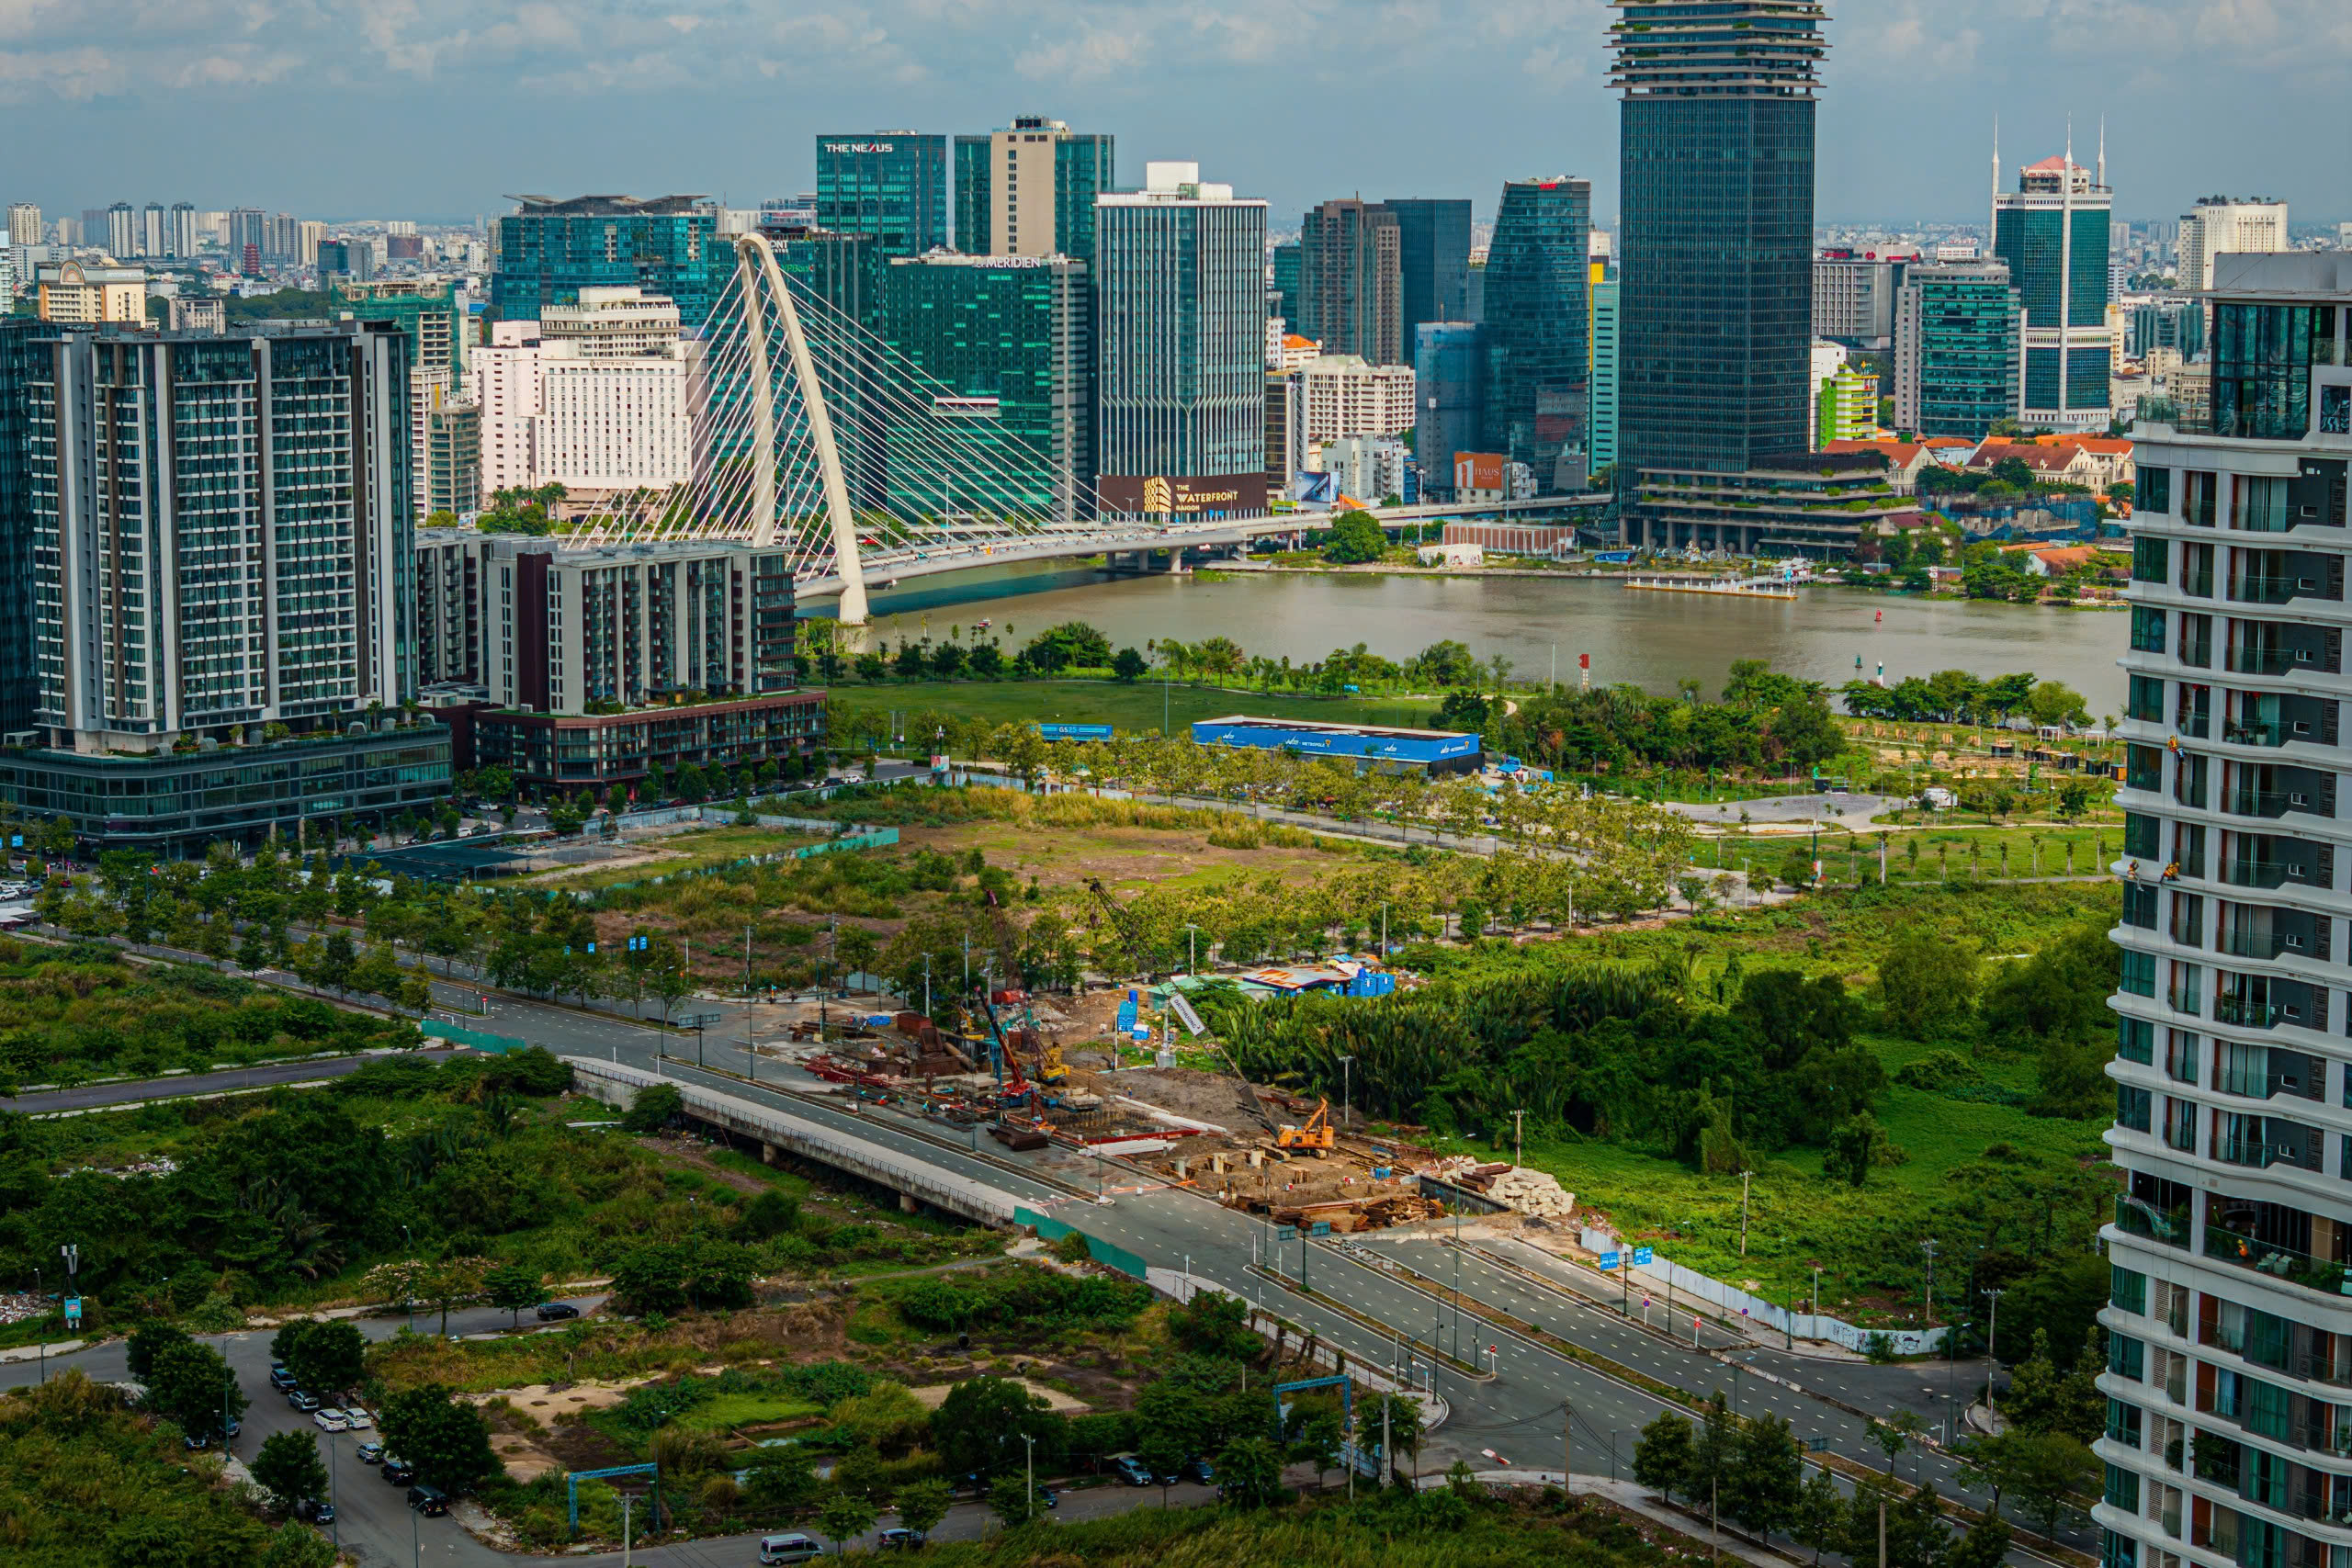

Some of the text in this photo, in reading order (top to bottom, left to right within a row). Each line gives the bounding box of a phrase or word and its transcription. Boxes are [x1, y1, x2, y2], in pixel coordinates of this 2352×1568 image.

[824, 142, 893, 152] THE NEXUS
[1475, 468, 1499, 477] HAUS
[1176, 491, 1238, 503] WATERFRONT
